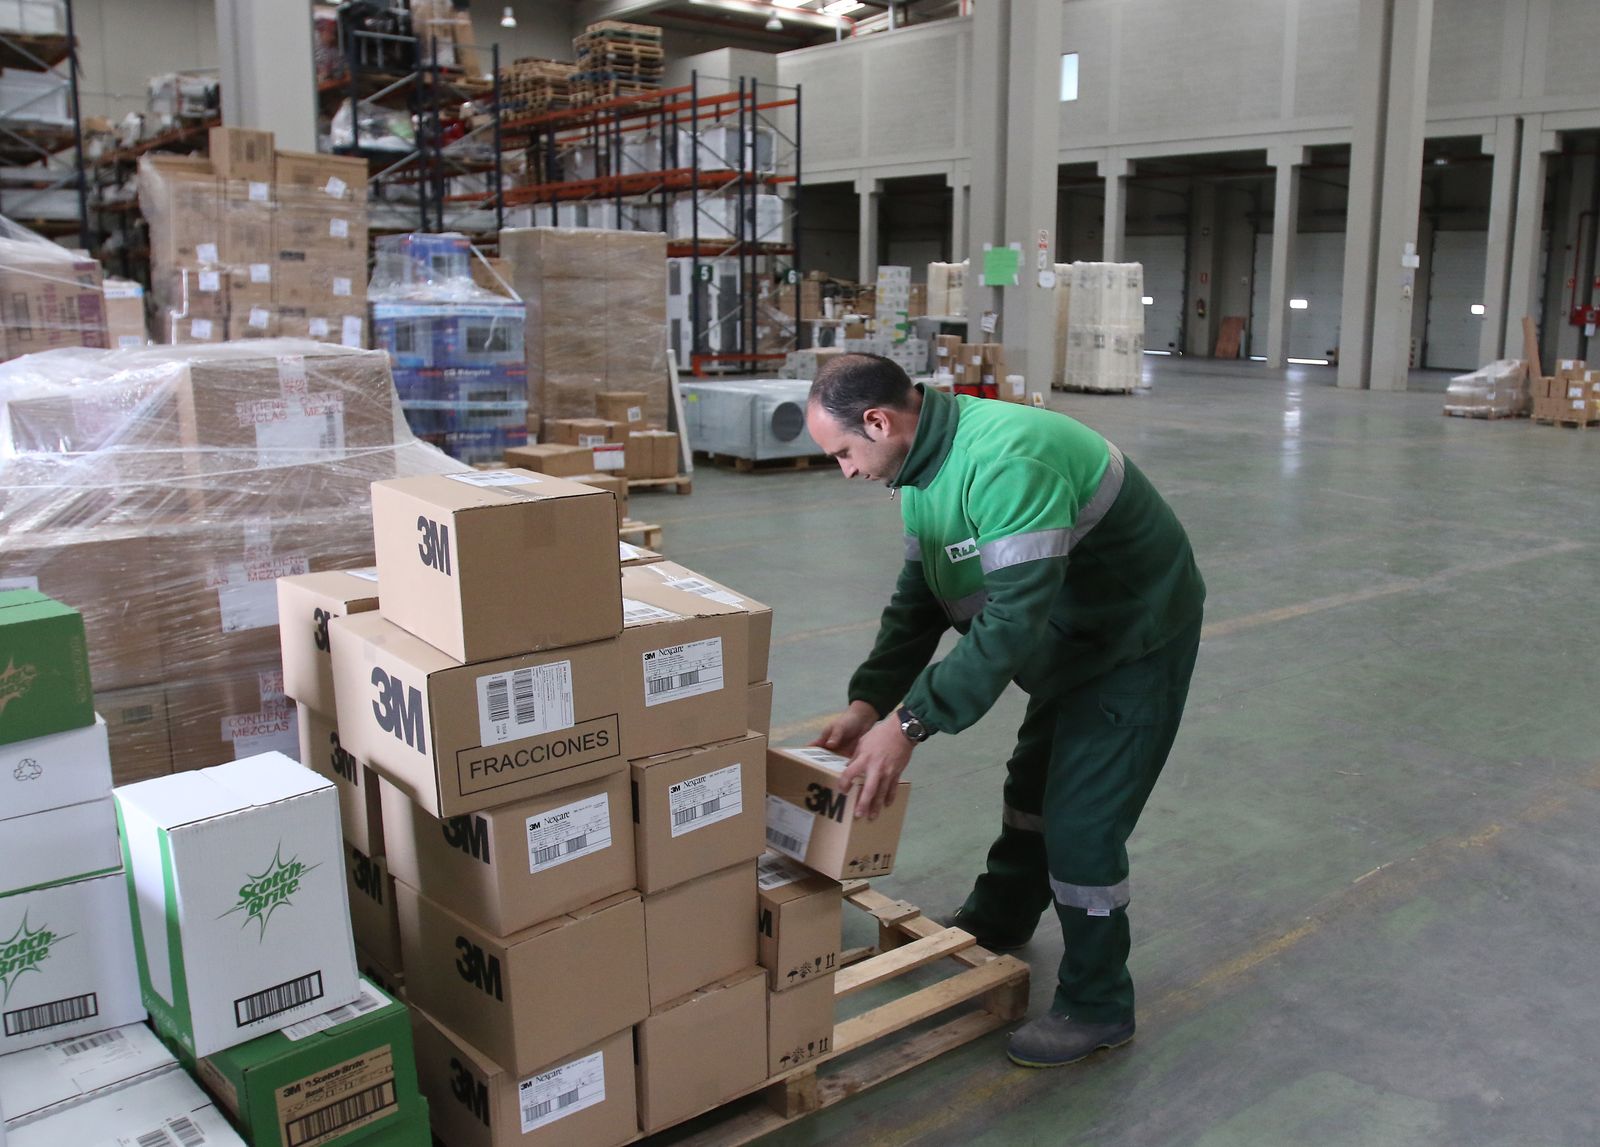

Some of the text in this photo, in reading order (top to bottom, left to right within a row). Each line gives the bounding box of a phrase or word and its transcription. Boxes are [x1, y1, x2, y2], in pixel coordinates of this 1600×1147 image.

[701, 265, 710, 281] 5
[787, 269, 797, 284] 6
[235, 401, 288, 417] ONTIENE
[240, 410, 288, 425] EZCLAS
[417, 515, 452, 577] 3M
[247, 565, 305, 583] MEZCLAS
[644, 645, 684, 661] 3M Nexcare
[229, 711, 291, 728] CONTIENE
[370, 666, 427, 755] 3M
[231, 720, 289, 738] MEZCLAS
[330, 731, 358, 787] 3M
[469, 729, 610, 780] FRACCIONES
[670, 775, 707, 794] 3M Nexcare
[805, 782, 848, 824] 3M
[529, 811, 570, 831] 3M Nexcare
[442, 814, 491, 865] 3M
[351, 850, 384, 906] 3M
[246, 878, 300, 917] Brite
[455, 935, 504, 1003] 3M
[520, 1067, 563, 1091] 3M Nexcare
[283, 1083, 302, 1098] 3M
[449, 1056, 490, 1128] 3M
